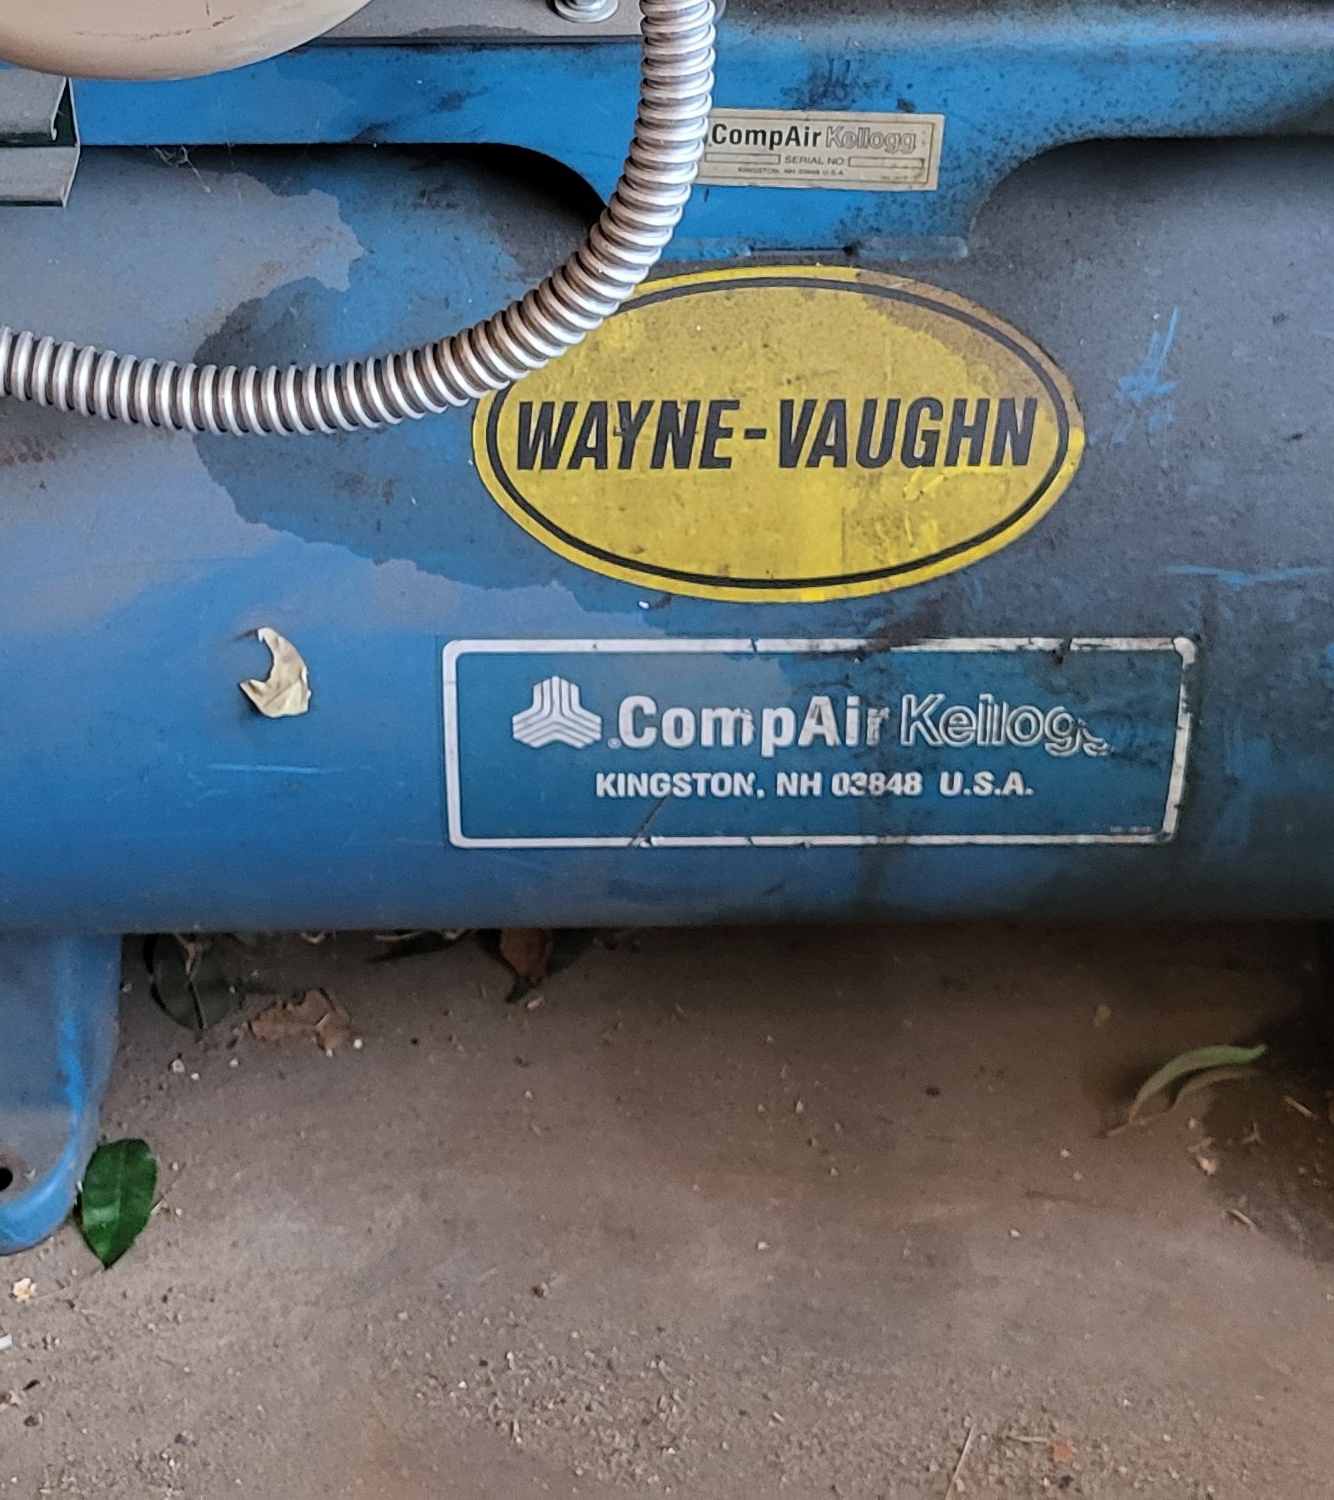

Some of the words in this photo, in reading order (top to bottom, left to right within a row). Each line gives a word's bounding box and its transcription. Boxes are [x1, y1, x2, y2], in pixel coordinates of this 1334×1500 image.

[711, 122, 823, 151] CompAir
[825, 125, 917, 154] Kellogg
[784, 155, 824, 165] SERIAL
[515, 396, 1038, 471] WAYNE-VAUGHN
[618, 694, 891, 758] CompAir
[596, 771, 766, 800] KINGSTON,
[776, 771, 823, 798] NH
[831, 771, 924, 797] 03848
[939, 770, 1035, 797] U.S.A.
